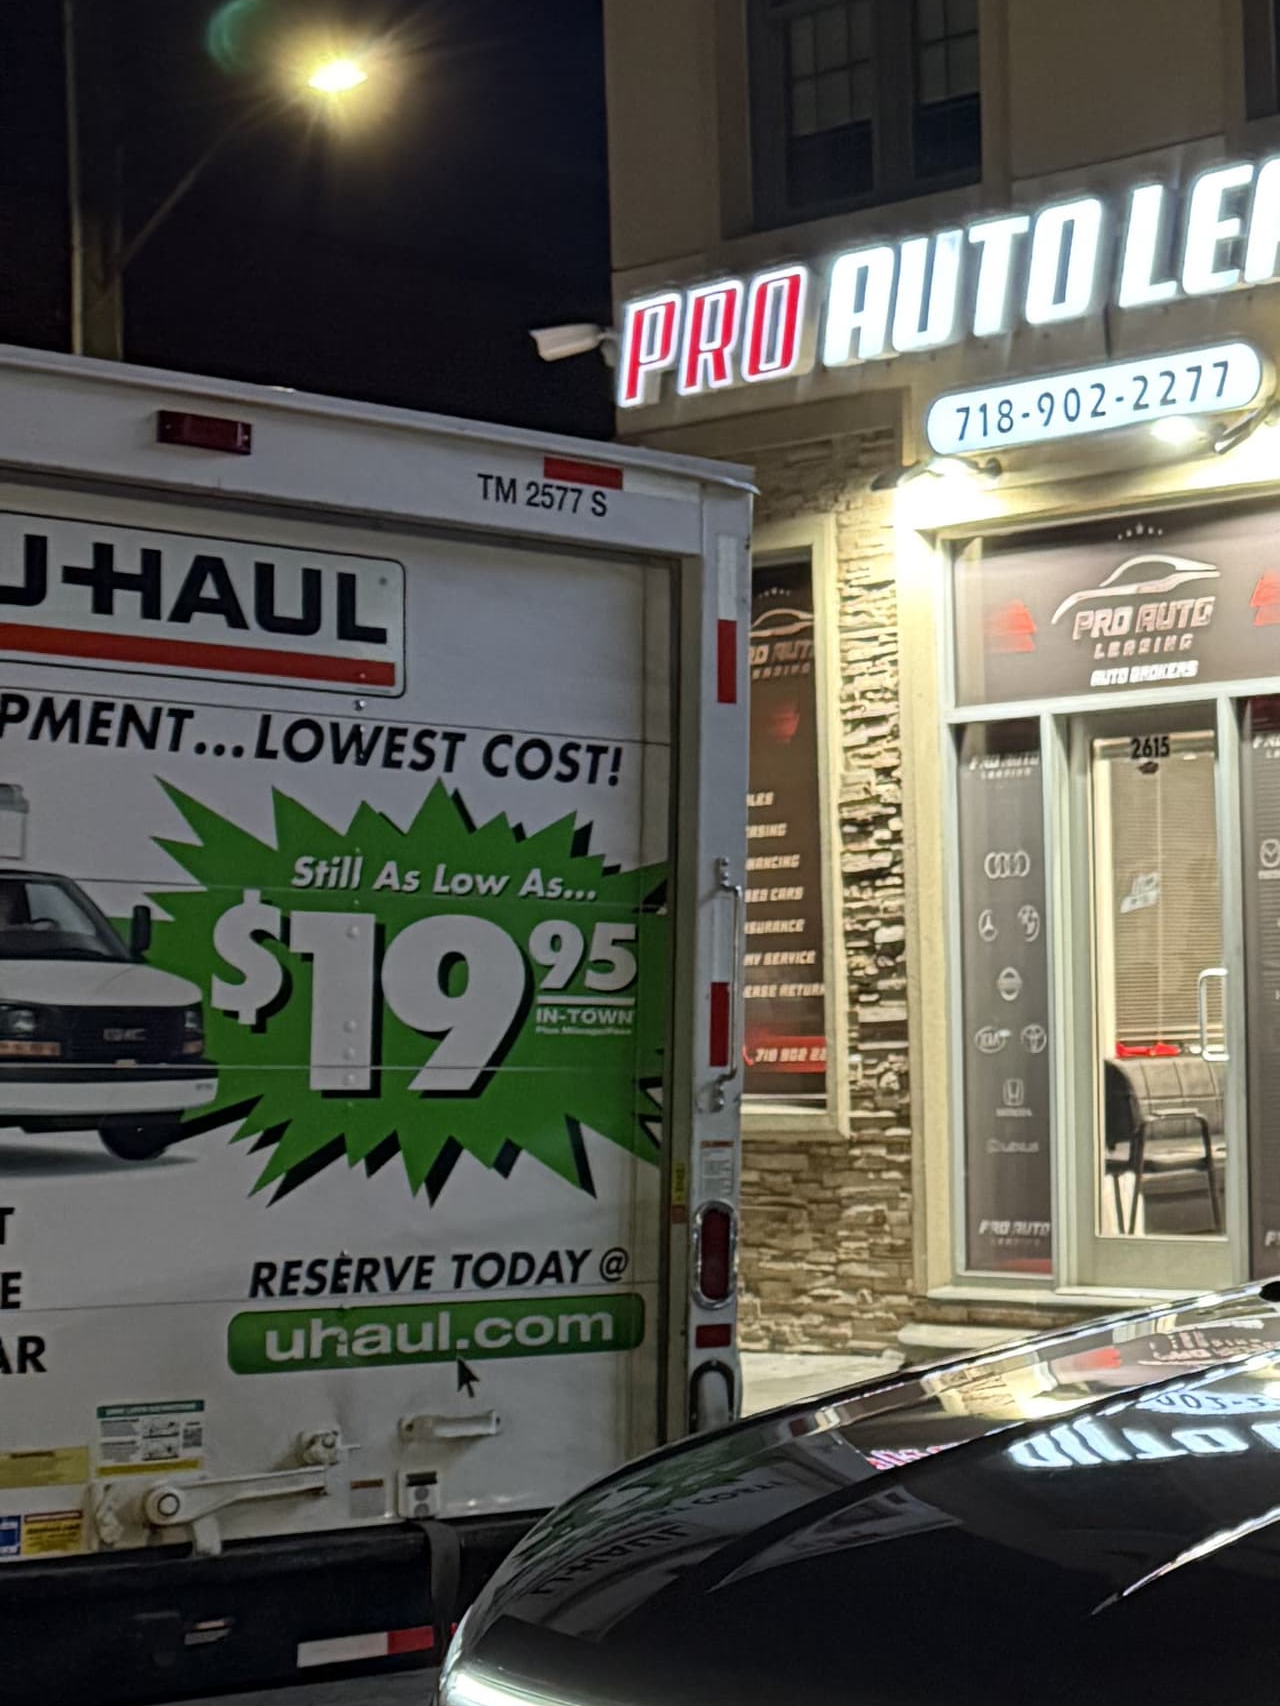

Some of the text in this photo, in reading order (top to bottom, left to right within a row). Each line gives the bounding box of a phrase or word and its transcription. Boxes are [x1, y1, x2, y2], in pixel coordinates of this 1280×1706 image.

[615, 262, 810, 411] PRO
[821, 194, 1105, 371] AUTO
[954, 359, 1232, 442] 718-902-2277
[476, 472, 609, 519] TM 2577 S
[1071, 595, 1217, 641] PRO AUTO
[1093, 632, 1194, 660] LEASING
[1090, 659, 1200, 687] AUTO BROKERS
[481, 737, 624, 787] COST!
[1129, 734, 1172, 760] 2615
[291, 856, 363, 890] Still
[373, 860, 422, 893] As
[433, 864, 509, 898] Low
[535, 1007, 635, 1024] IN-TOWN
[249, 1246, 632, 1299] RESERVE TODAY @
[264, 1306, 615, 1363] uhaul.com
